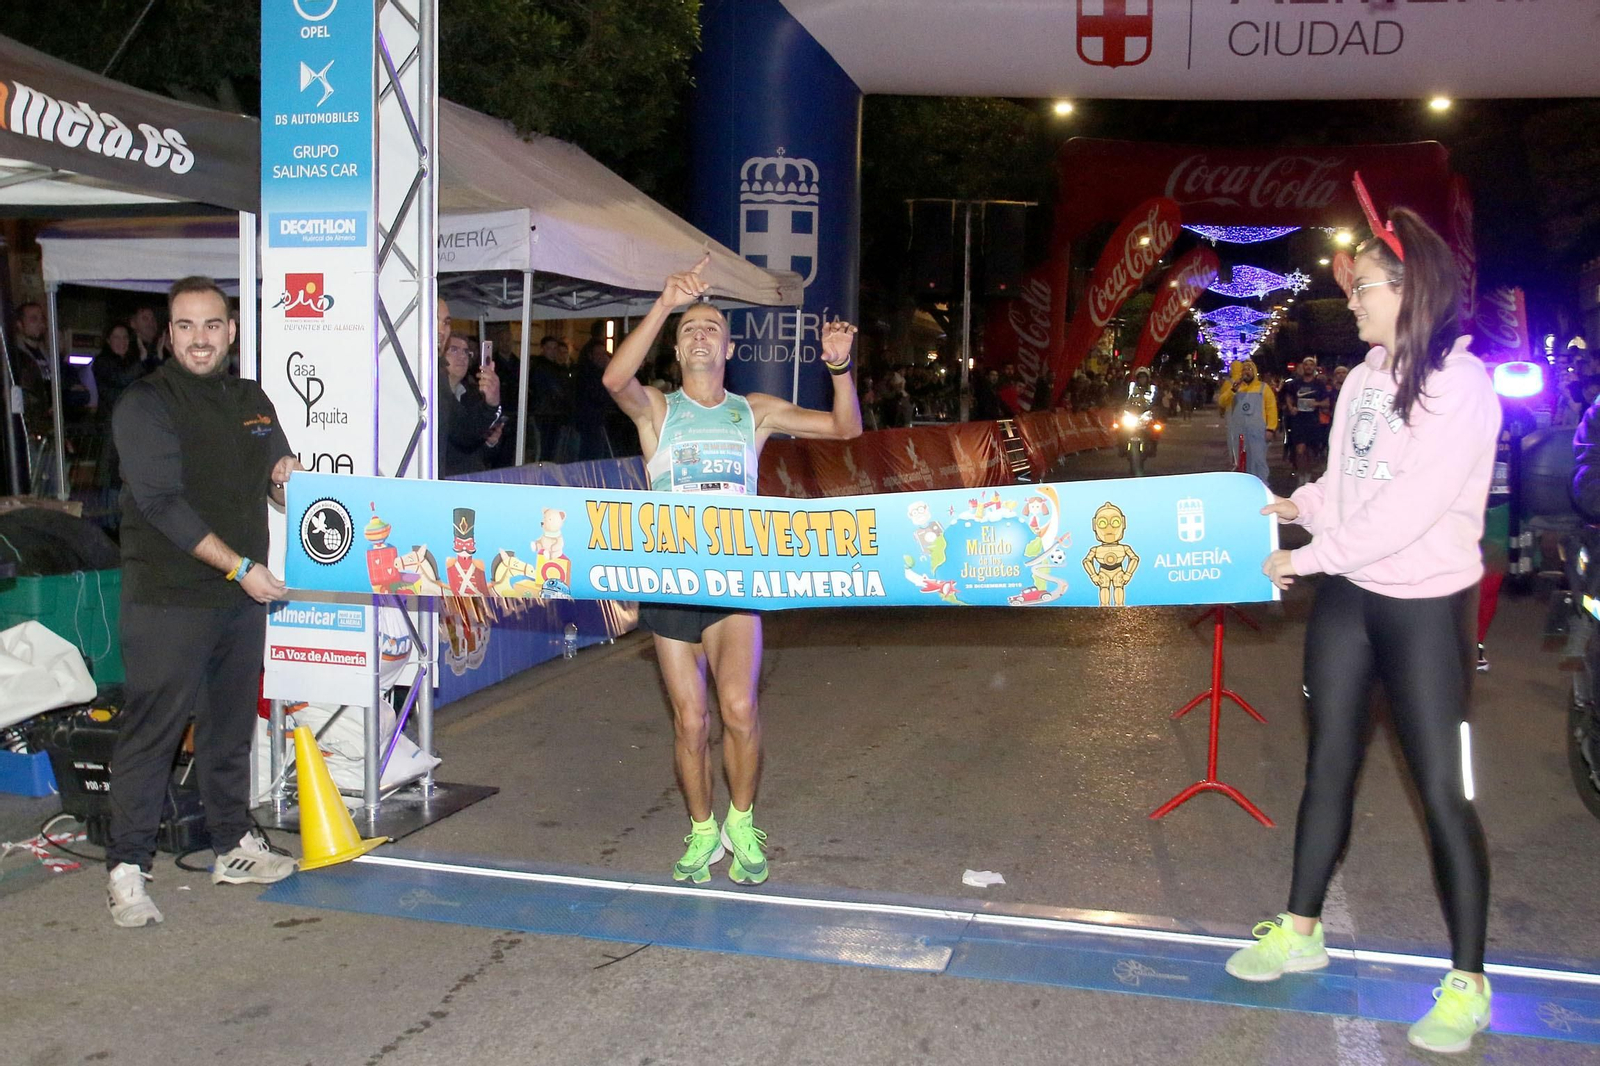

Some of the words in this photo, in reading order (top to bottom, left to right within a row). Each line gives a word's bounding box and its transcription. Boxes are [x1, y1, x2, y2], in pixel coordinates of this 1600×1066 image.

[301, 26, 331, 39] OPEL
[1228, 20, 1404, 57] CIUDAD
[275, 115, 288, 125] DS
[291, 112, 359, 124] AUTOMOBILES
[293, 145, 339, 158] GRUPO
[273, 165, 328, 178] SALINAS
[331, 164, 358, 177] CAR
[280, 219, 356, 235] DECATHLON
[737, 344, 816, 363] CIUDAD
[306, 377, 348, 430] Paquita
[702, 459, 742, 475] 2579
[586, 500, 633, 551] XII
[638, 503, 698, 555] SAN
[702, 506, 879, 558] SILVESTRE
[981, 525, 996, 544] El
[966, 538, 1012, 556] Mundo
[1153, 547, 1232, 568] ALMERÍA
[589, 565, 700, 597] CIUDAD
[704, 569, 745, 597] DE
[752, 563, 887, 598] ALMERÍA
[960, 562, 1020, 581] Juguetes
[1168, 567, 1221, 582] CIUDAD
[273, 606, 336, 626] Almericar
[271, 647, 285, 660] La
[286, 648, 307, 661] Voz
[308, 650, 322, 662] de
[322, 651, 366, 665] Almería
